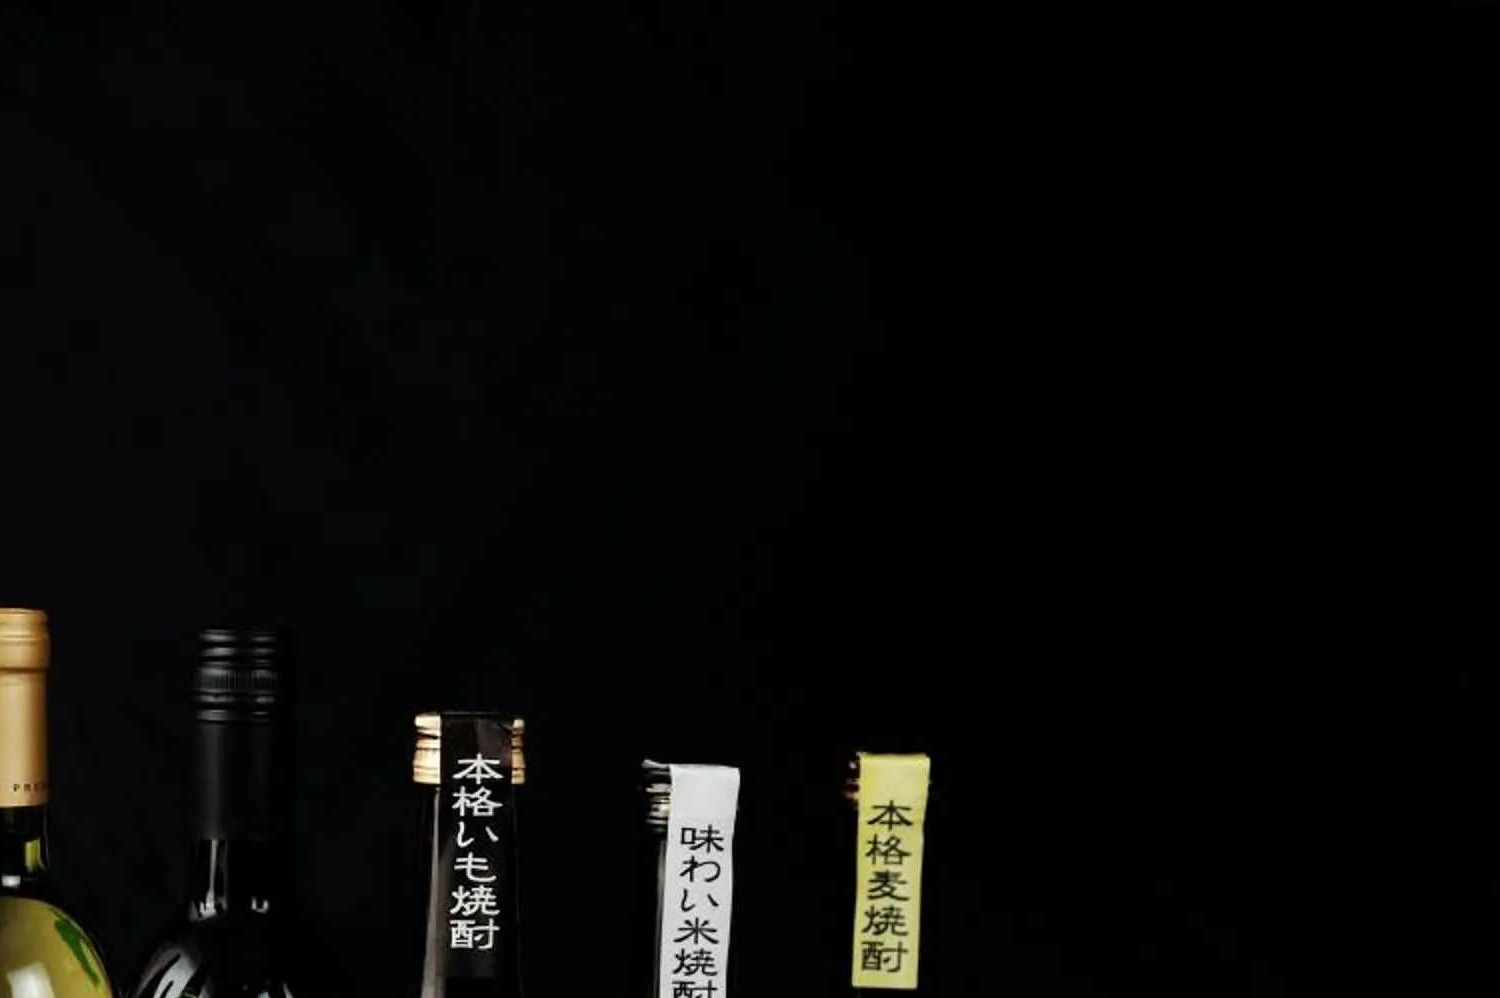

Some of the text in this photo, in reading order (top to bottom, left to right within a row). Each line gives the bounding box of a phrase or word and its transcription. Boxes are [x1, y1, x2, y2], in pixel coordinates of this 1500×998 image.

[449, 753, 504, 950] 本格いも焼酎
[861, 799, 915, 974] 本格麦焼酎
